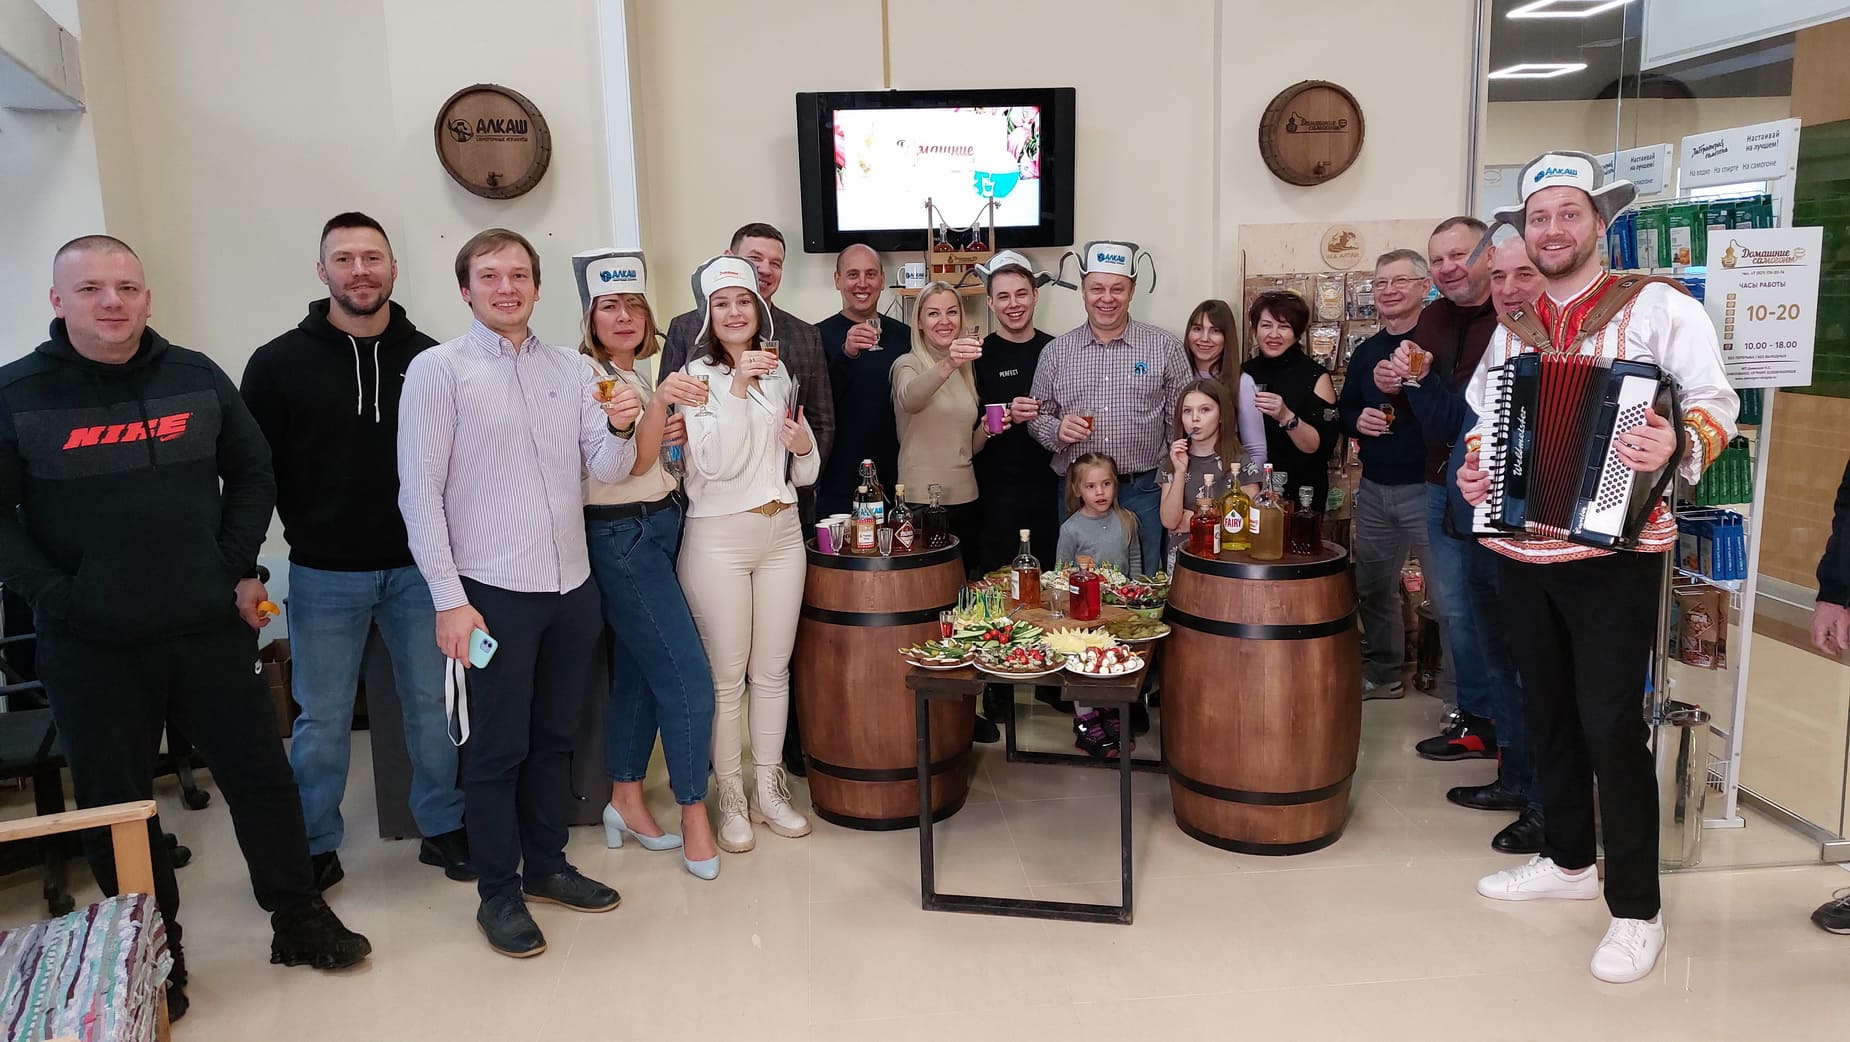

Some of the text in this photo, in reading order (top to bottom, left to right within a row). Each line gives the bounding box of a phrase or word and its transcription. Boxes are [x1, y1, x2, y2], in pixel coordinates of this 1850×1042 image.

[476, 118, 528, 134] АЛКАШ
[1746, 130, 1780, 143] Настаивай
[1753, 140, 1779, 152] лучшем!
[1750, 160, 1777, 169] самогоне
[1545, 167, 1578, 176] АЛКАШ
[1741, 248, 1791, 258] Домашние
[1105, 254, 1125, 263] АЛКАШ
[1752, 256, 1796, 265] самогоны
[613, 270, 636, 278] АЛКАШ
[1746, 304, 1800, 321] 10-20
[1744, 342, 1767, 350] 10.00
[1776, 341, 1798, 349] 18.00
[999, 369, 1019, 378] PERFECT
[63, 412, 191, 450] NIKE
[1512, 406, 1527, 477] Weltmeister
[1224, 517, 1242, 528] FAIRY
